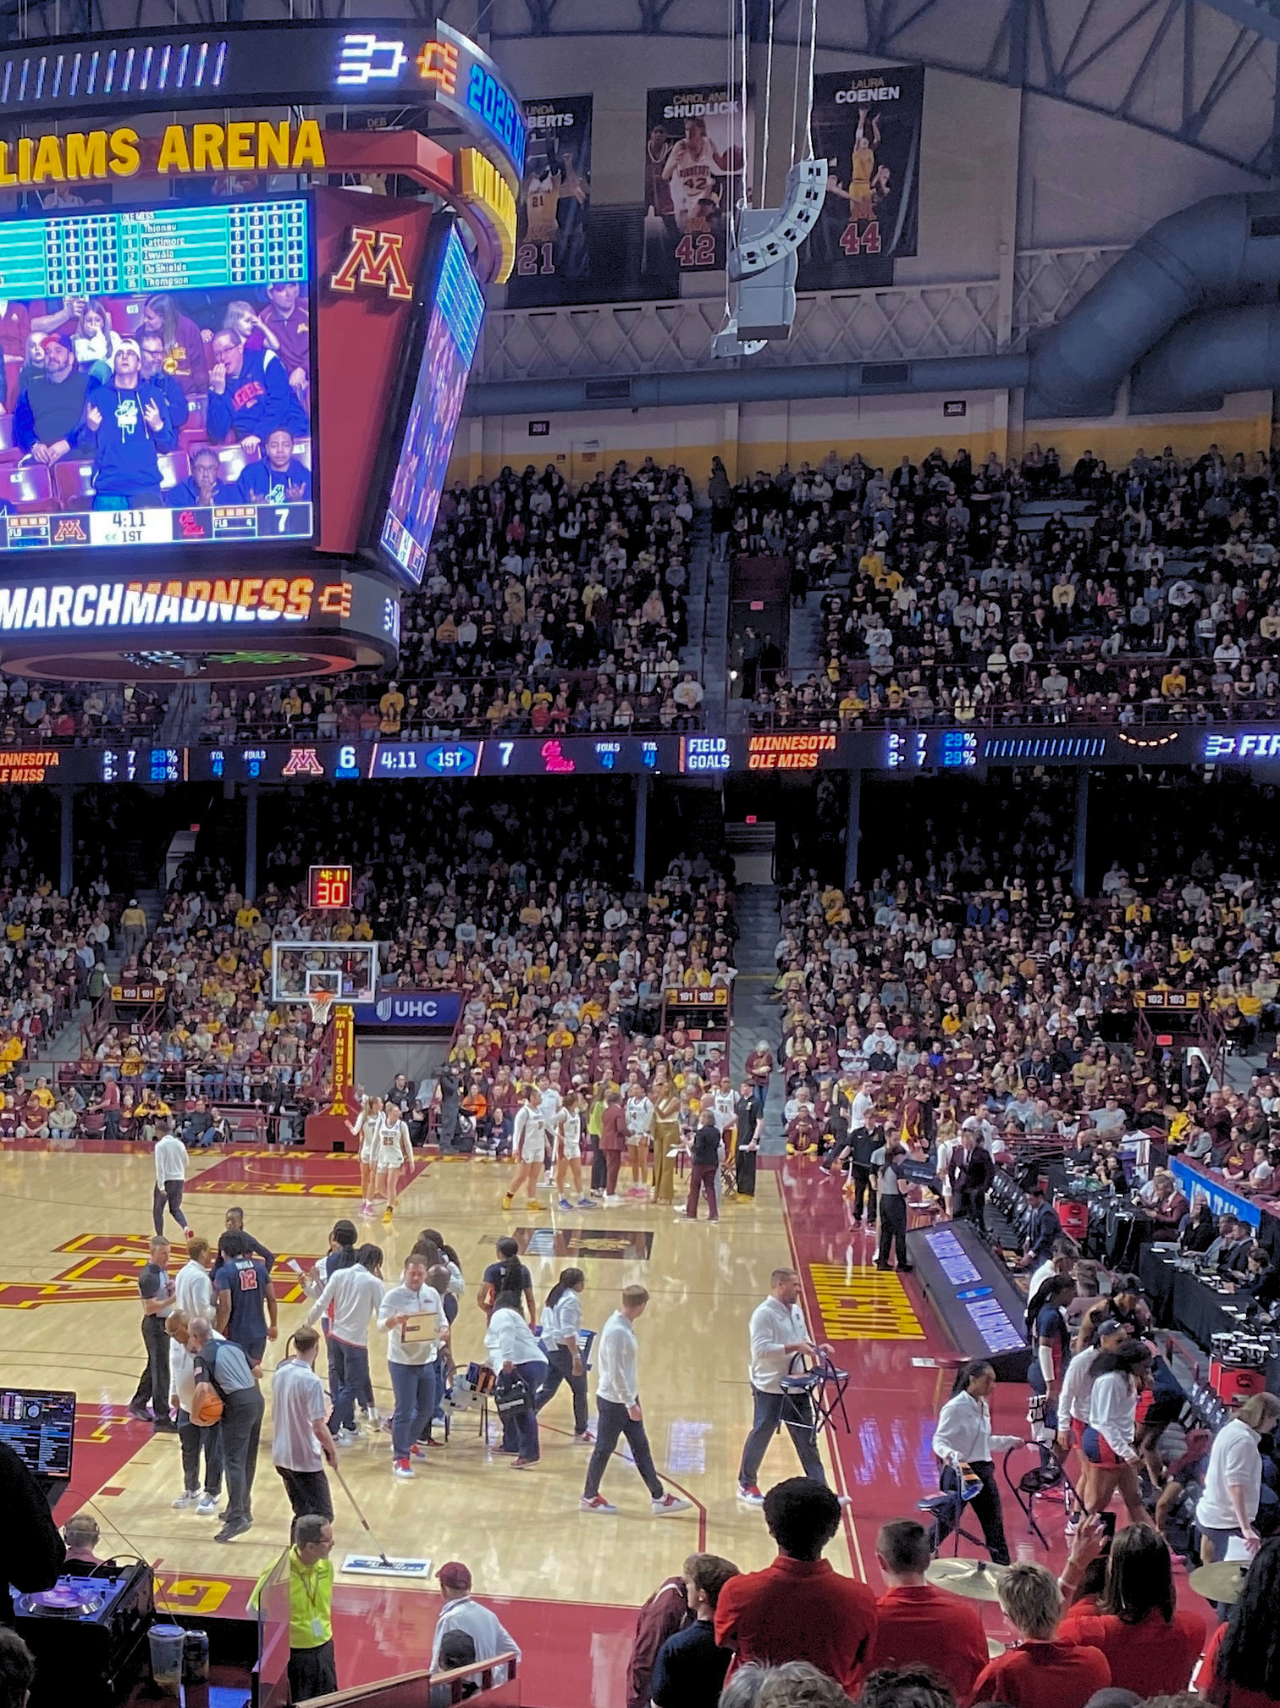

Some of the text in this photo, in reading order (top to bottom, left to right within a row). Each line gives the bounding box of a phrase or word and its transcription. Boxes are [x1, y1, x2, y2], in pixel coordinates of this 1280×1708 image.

[851, 76, 885, 89] LAURA
[469, 63, 515, 144] 2026
[672, 94, 703, 106] CAROL
[835, 86, 900, 104] COENEN
[663, 100, 739, 120] SHUDLICK
[157, 118, 328, 176] ARENA
[839, 221, 882, 256] 44
[675, 233, 715, 266] 42
[330, 228, 413, 300] M
[518, 243, 555, 276] 21
[112, 511, 146, 528] 4:11
[275, 508, 290, 533] 7
[122, 530, 142, 542] 1ST
[689, 738, 727, 752] FIELD
[749, 735, 836, 751] MINNESOTA
[917, 733, 927, 748] 7
[945, 733, 977, 747] 29%
[128, 751, 136, 763] 7
[282, 748, 323, 776] M
[340, 746, 355, 768] 6
[381, 751, 463, 769] 4:11 1ST
[499, 743, 514, 766] 7
[602, 752, 614, 769] 4
[644, 752, 656, 768] 4
[688, 754, 730, 768] GOALS
[749, 754, 775, 768] OLE
[778, 753, 818, 768] MISS
[917, 750, 926, 766] 7
[944, 751, 976, 765] 29%
[10, 768, 45, 782] MISS
[128, 767, 136, 780] 7
[250, 762, 260, 776] 3
[320, 870, 348, 882] 4:11
[317, 883, 344, 904] 30
[680, 992, 714, 1001] 101 102
[1147, 995, 1163, 1004] 102
[395, 1001, 437, 1018] UHC
[335, 1020, 346, 1100] MINNESOTA
[383, 1136, 394, 1146] 25
[239, 1269, 258, 1291] 12
